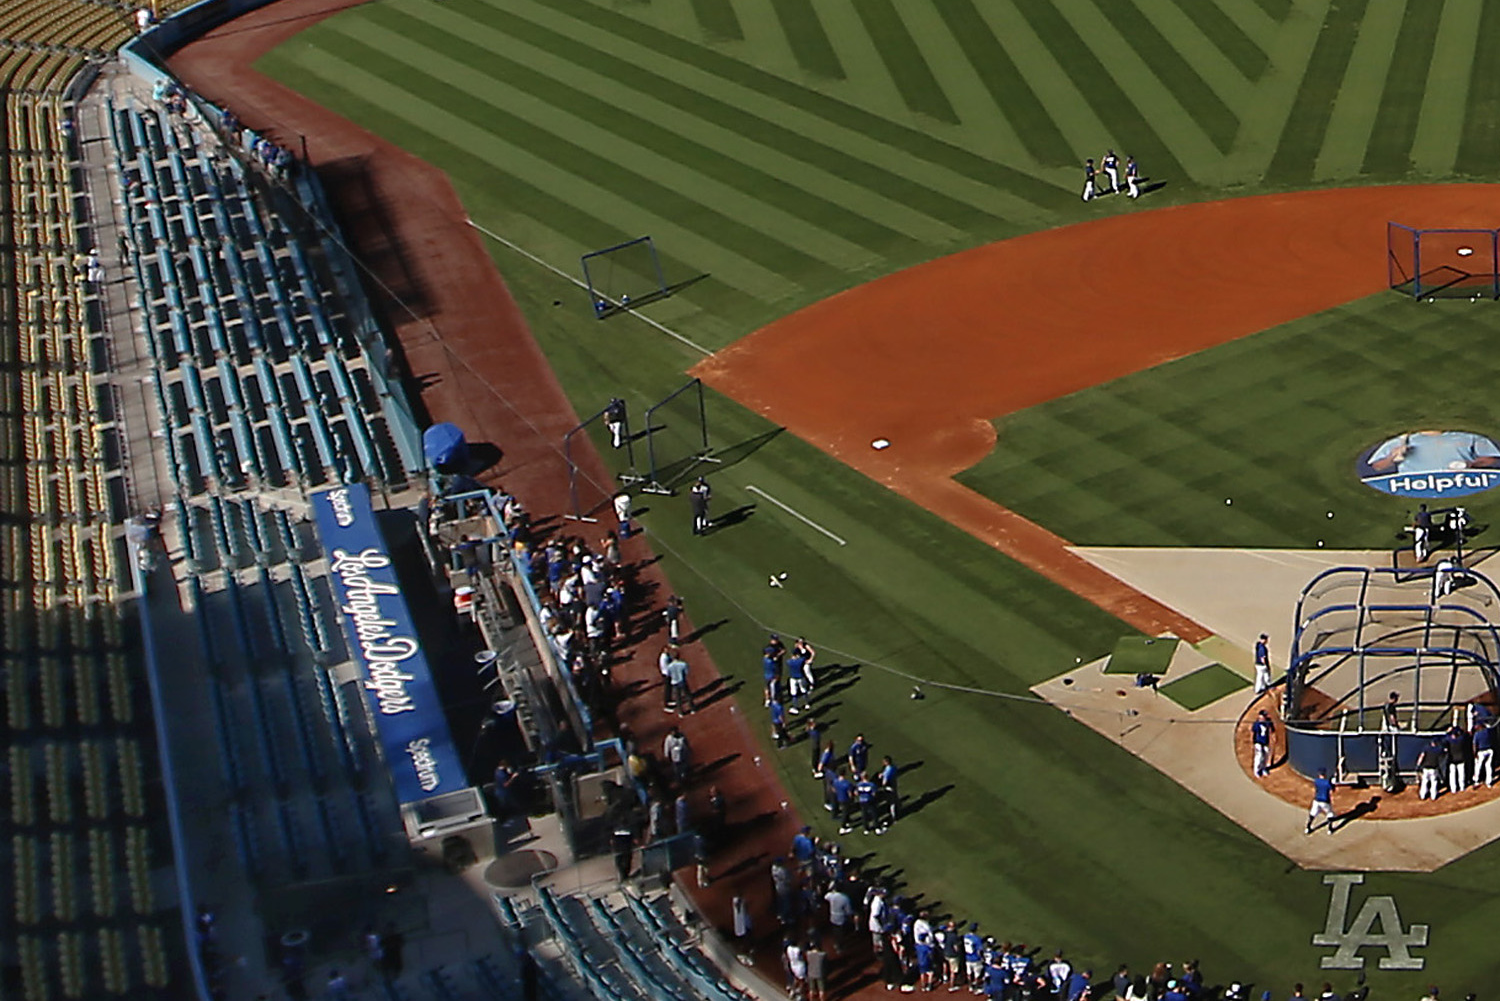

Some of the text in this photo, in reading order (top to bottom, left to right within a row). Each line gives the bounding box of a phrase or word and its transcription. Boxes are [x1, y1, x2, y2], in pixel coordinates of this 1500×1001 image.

[326, 488, 353, 527] Spectrum
[1389, 474, 1490, 493] Helpful
[342, 580, 399, 644] Angeles
[364, 636, 418, 714] Dodgers
[405, 737, 439, 792] Spectrum
[1313, 874, 1429, 969] LA
